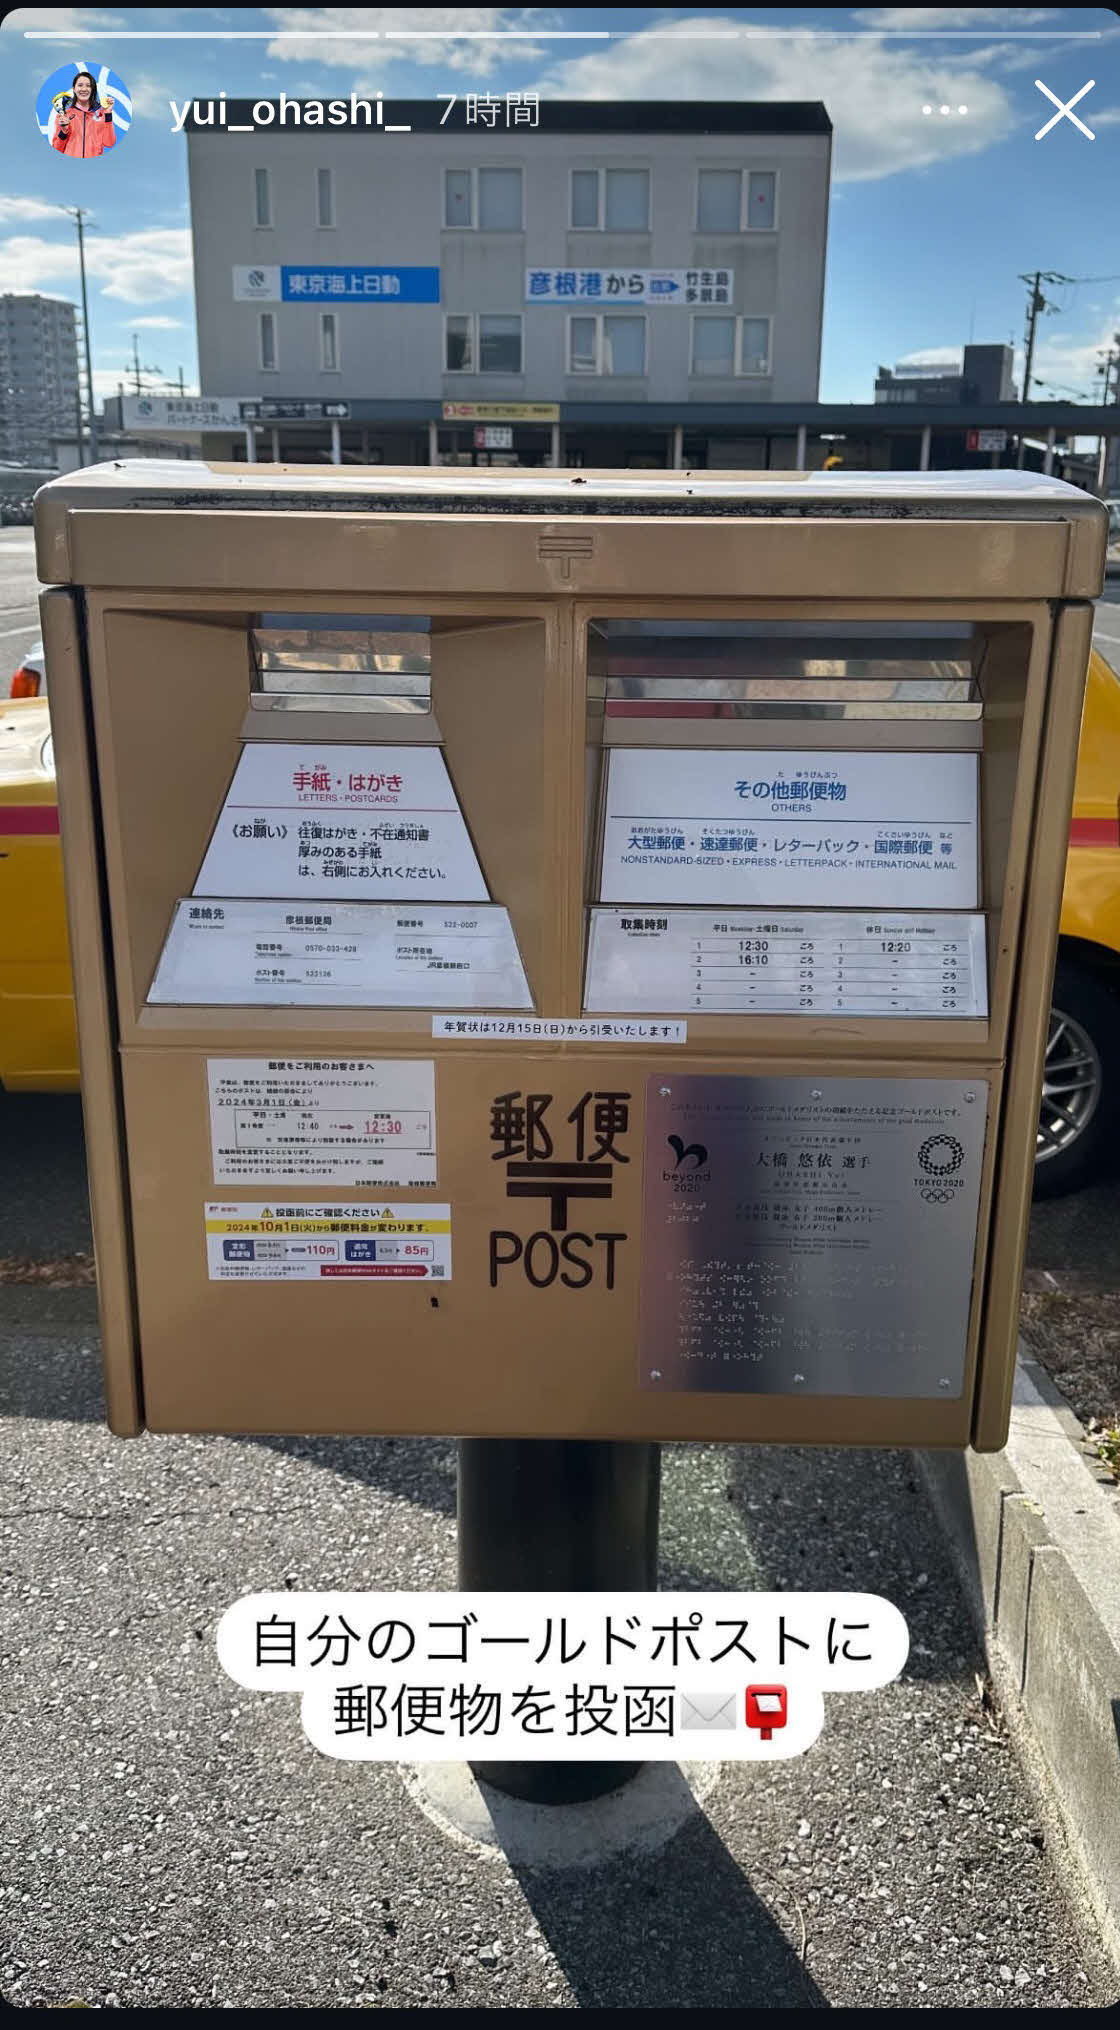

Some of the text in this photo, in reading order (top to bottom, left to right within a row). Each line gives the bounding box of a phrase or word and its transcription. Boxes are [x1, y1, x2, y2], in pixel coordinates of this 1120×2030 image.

[288, 274, 401, 295] 東京海上日動
[529, 272, 644, 296] 彦根港から
[293, 772, 402, 792] 手紙・はがき
[734, 781, 847, 800] その他郵便物
[771, 803, 812, 812] OTHERS
[298, 846, 382, 860] 厚みのある手紙
[934, 860, 958, 870] MAIL
[189, 907, 225, 920] 連絡先
[621, 918, 668, 930] 取集時刻
[713, 924, 728, 933] 平日
[739, 940, 769, 951] 12:30
[881, 942, 911, 952] 12:20
[739, 955, 769, 965] 16:10
[268, 1062, 375, 1071] 郵便をご利用のお客さまへ
[365, 1120, 402, 1134] 12:30
[490, 1091, 631, 1163] 郵便
[755, 1151, 788, 1168] 大橋
[663, 1168, 712, 1184] beyond
[673, 1184, 702, 1193] 2020
[913, 1178, 965, 1188] TOKYO 2020
[276, 1208, 380, 1217] 投函前にご確認ください
[306, 1245, 335, 1256] 110円
[404, 1245, 429, 1256] 85円
[490, 1231, 628, 1289] POST
